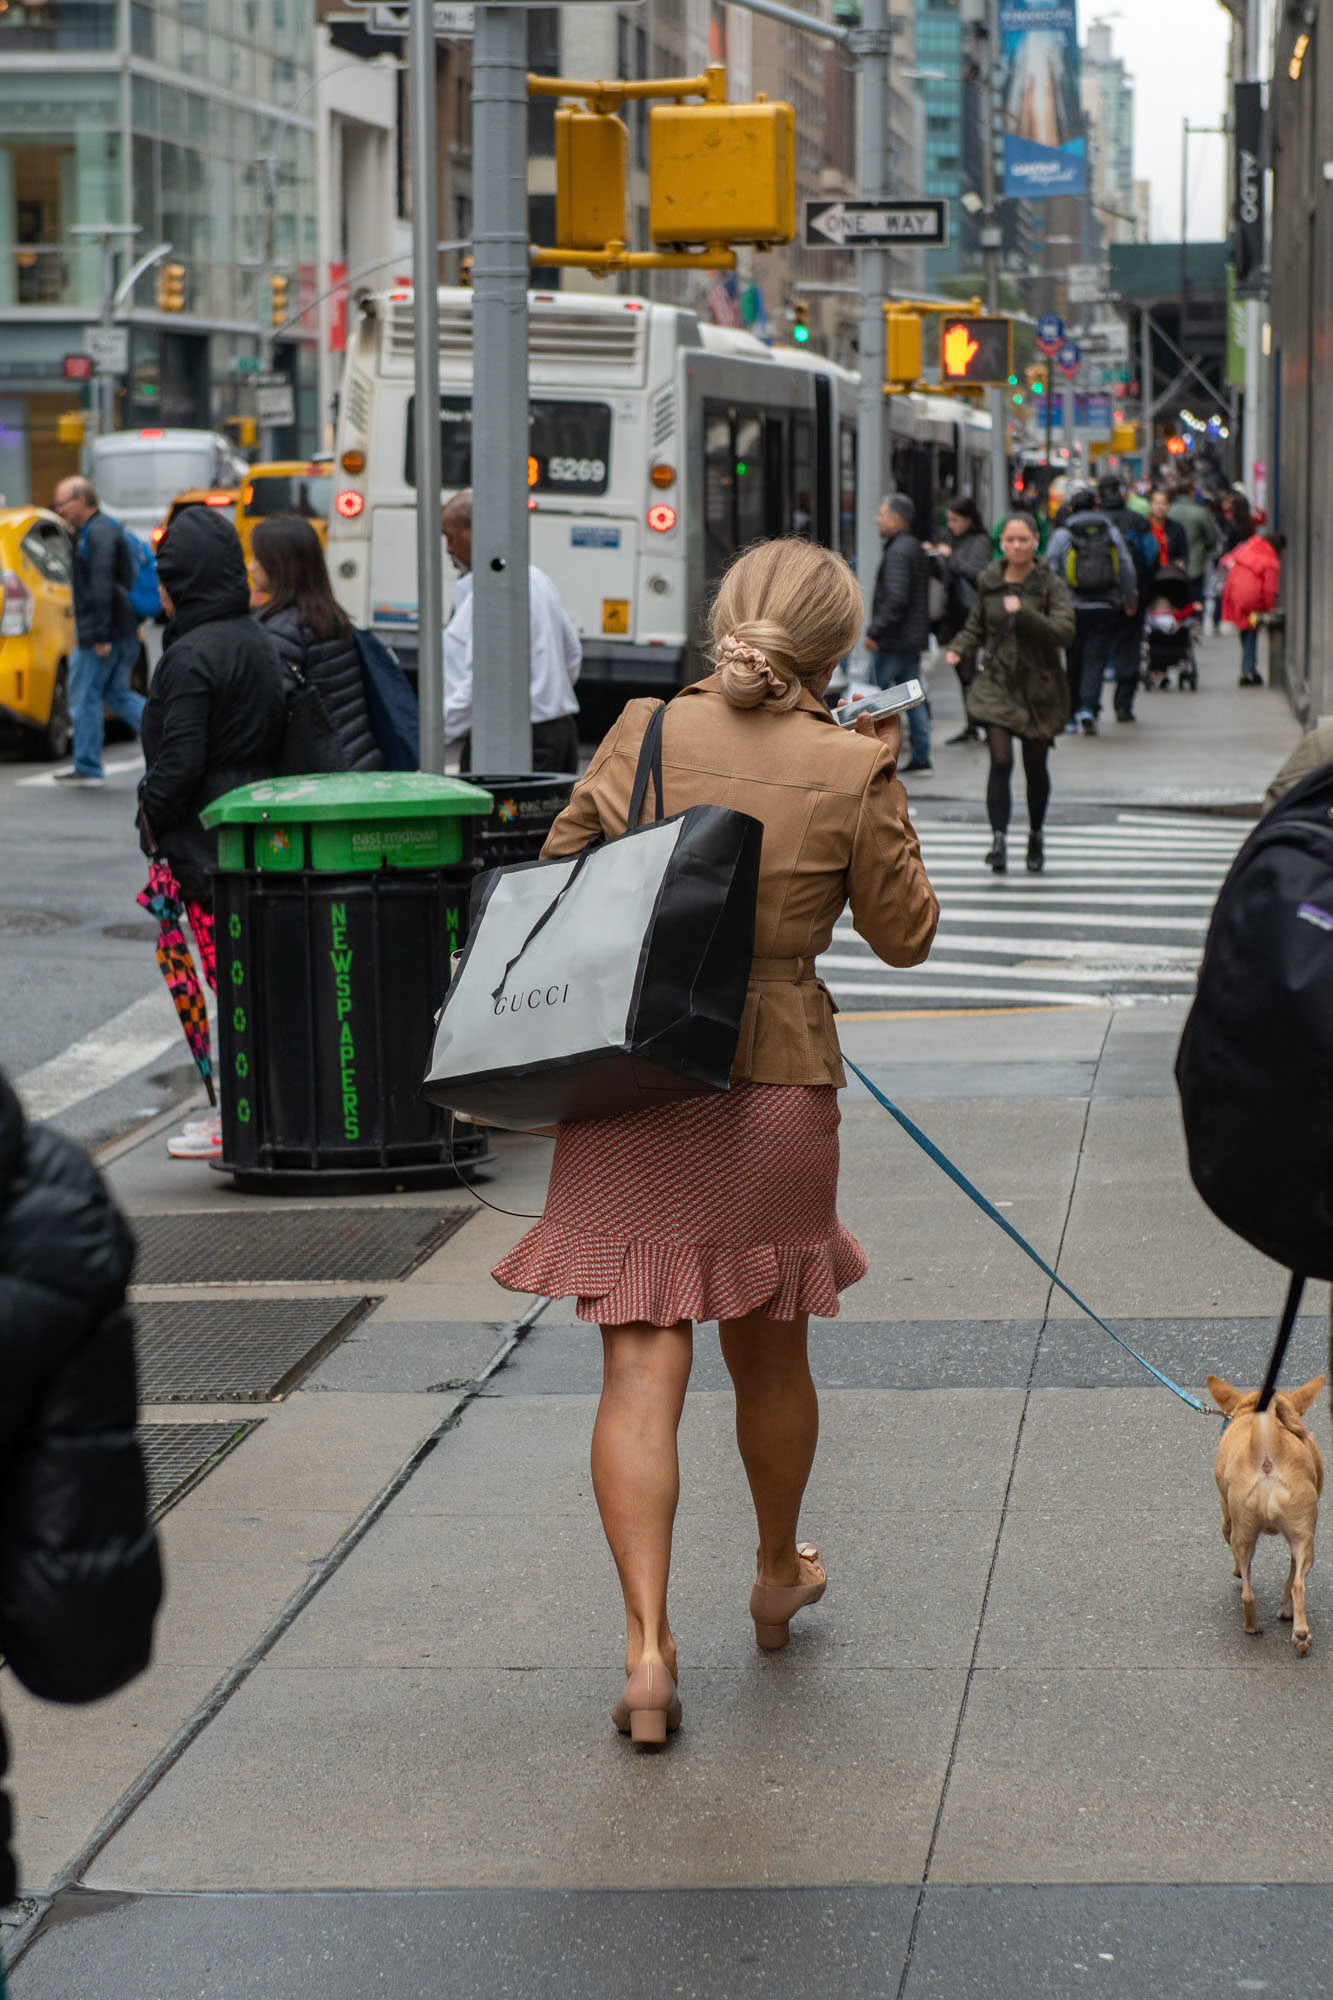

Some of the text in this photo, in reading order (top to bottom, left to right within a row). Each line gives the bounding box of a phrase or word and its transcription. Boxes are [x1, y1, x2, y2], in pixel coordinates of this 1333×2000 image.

[1240, 148, 1258, 223] ALDO
[827, 214, 929, 234] ONE WAY
[548, 457, 605, 482] 5269
[352, 828, 438, 845] east midtown
[494, 984, 568, 1015] GUCCI
[330, 903, 360, 1139] NEWSPAPERS
